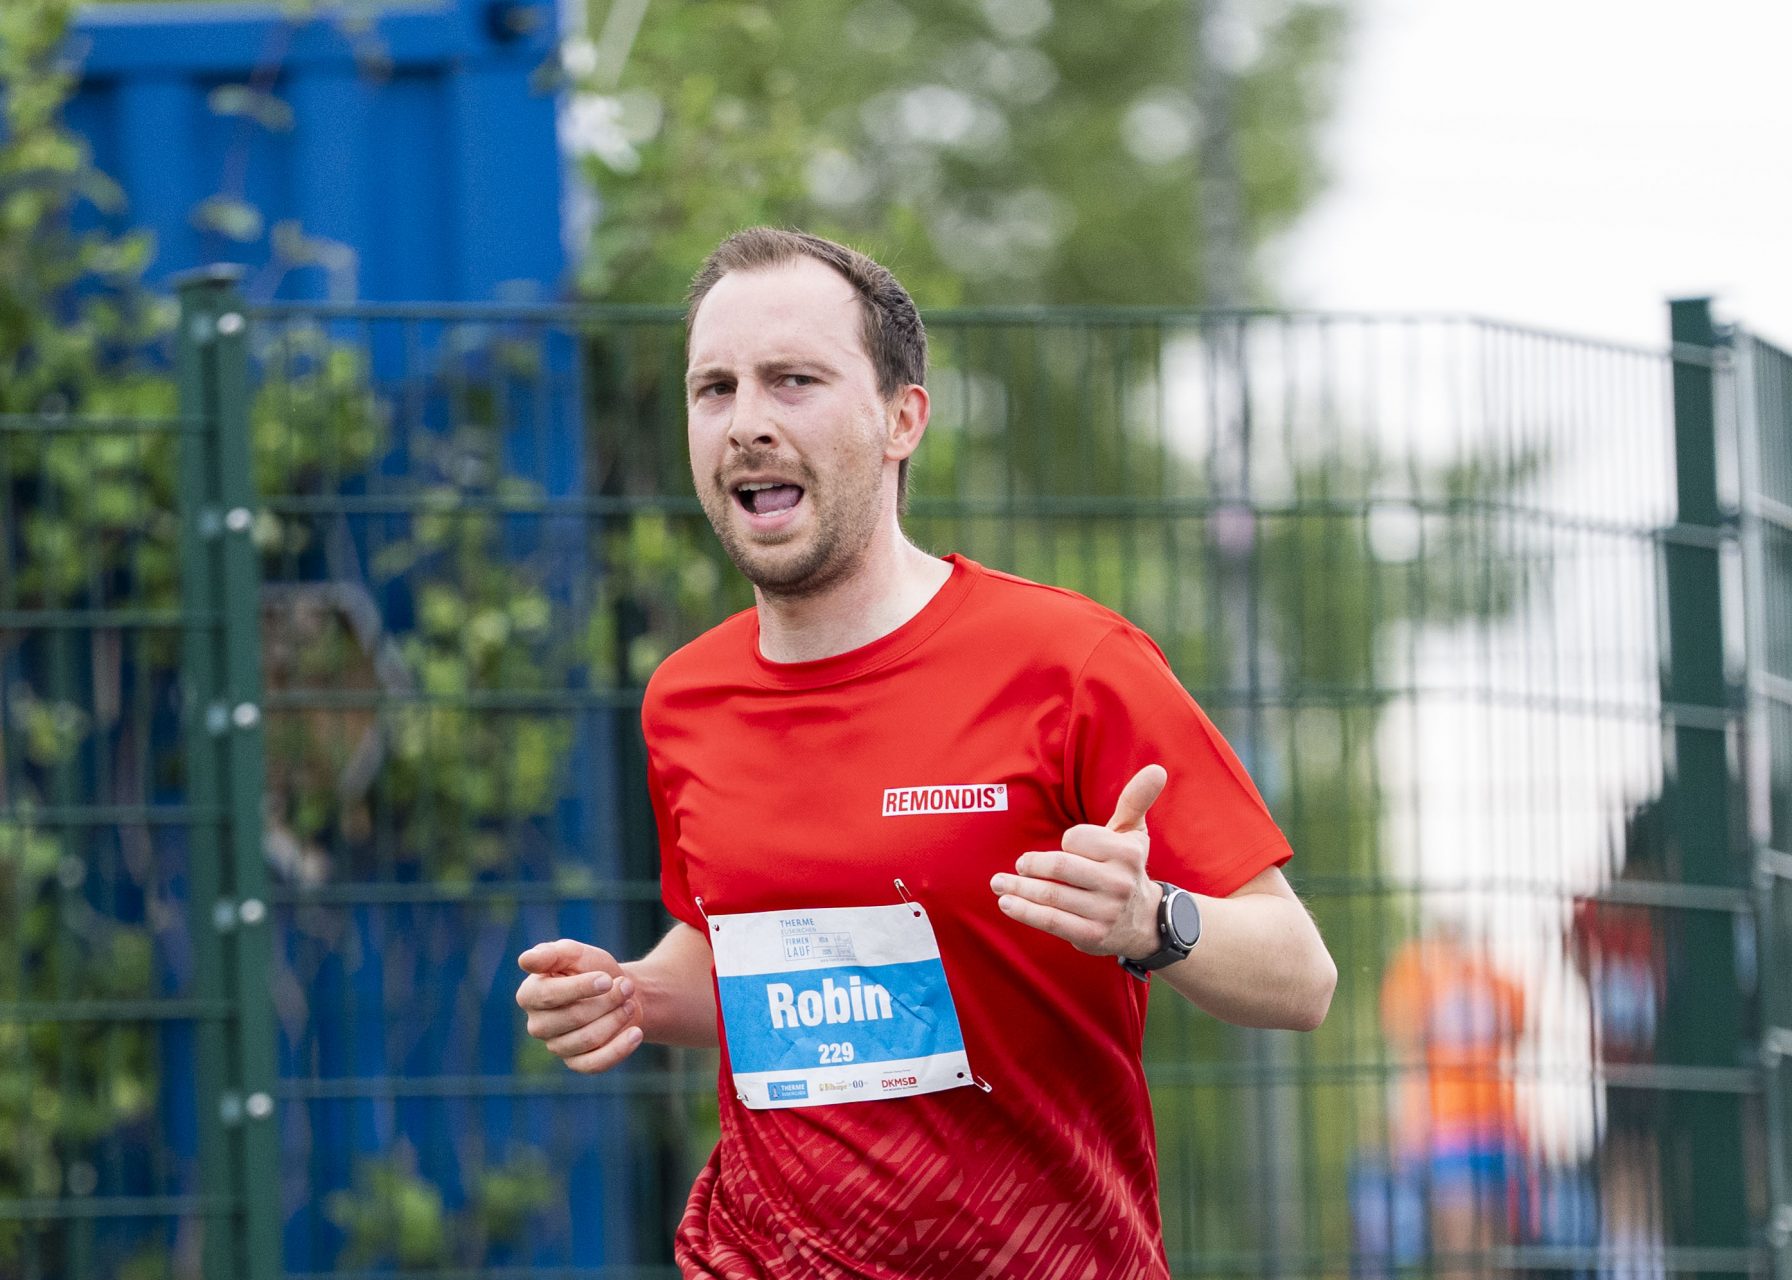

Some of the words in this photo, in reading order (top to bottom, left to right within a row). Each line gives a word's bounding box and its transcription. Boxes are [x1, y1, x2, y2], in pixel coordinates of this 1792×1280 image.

[780, 917, 815, 928] THERME
[785, 937, 809, 946] FIRMEN
[786, 946, 811, 958] LAUF
[766, 976, 893, 1029] Robin
[818, 1042, 855, 1064] 229
[881, 1077, 909, 1088] DKMS
